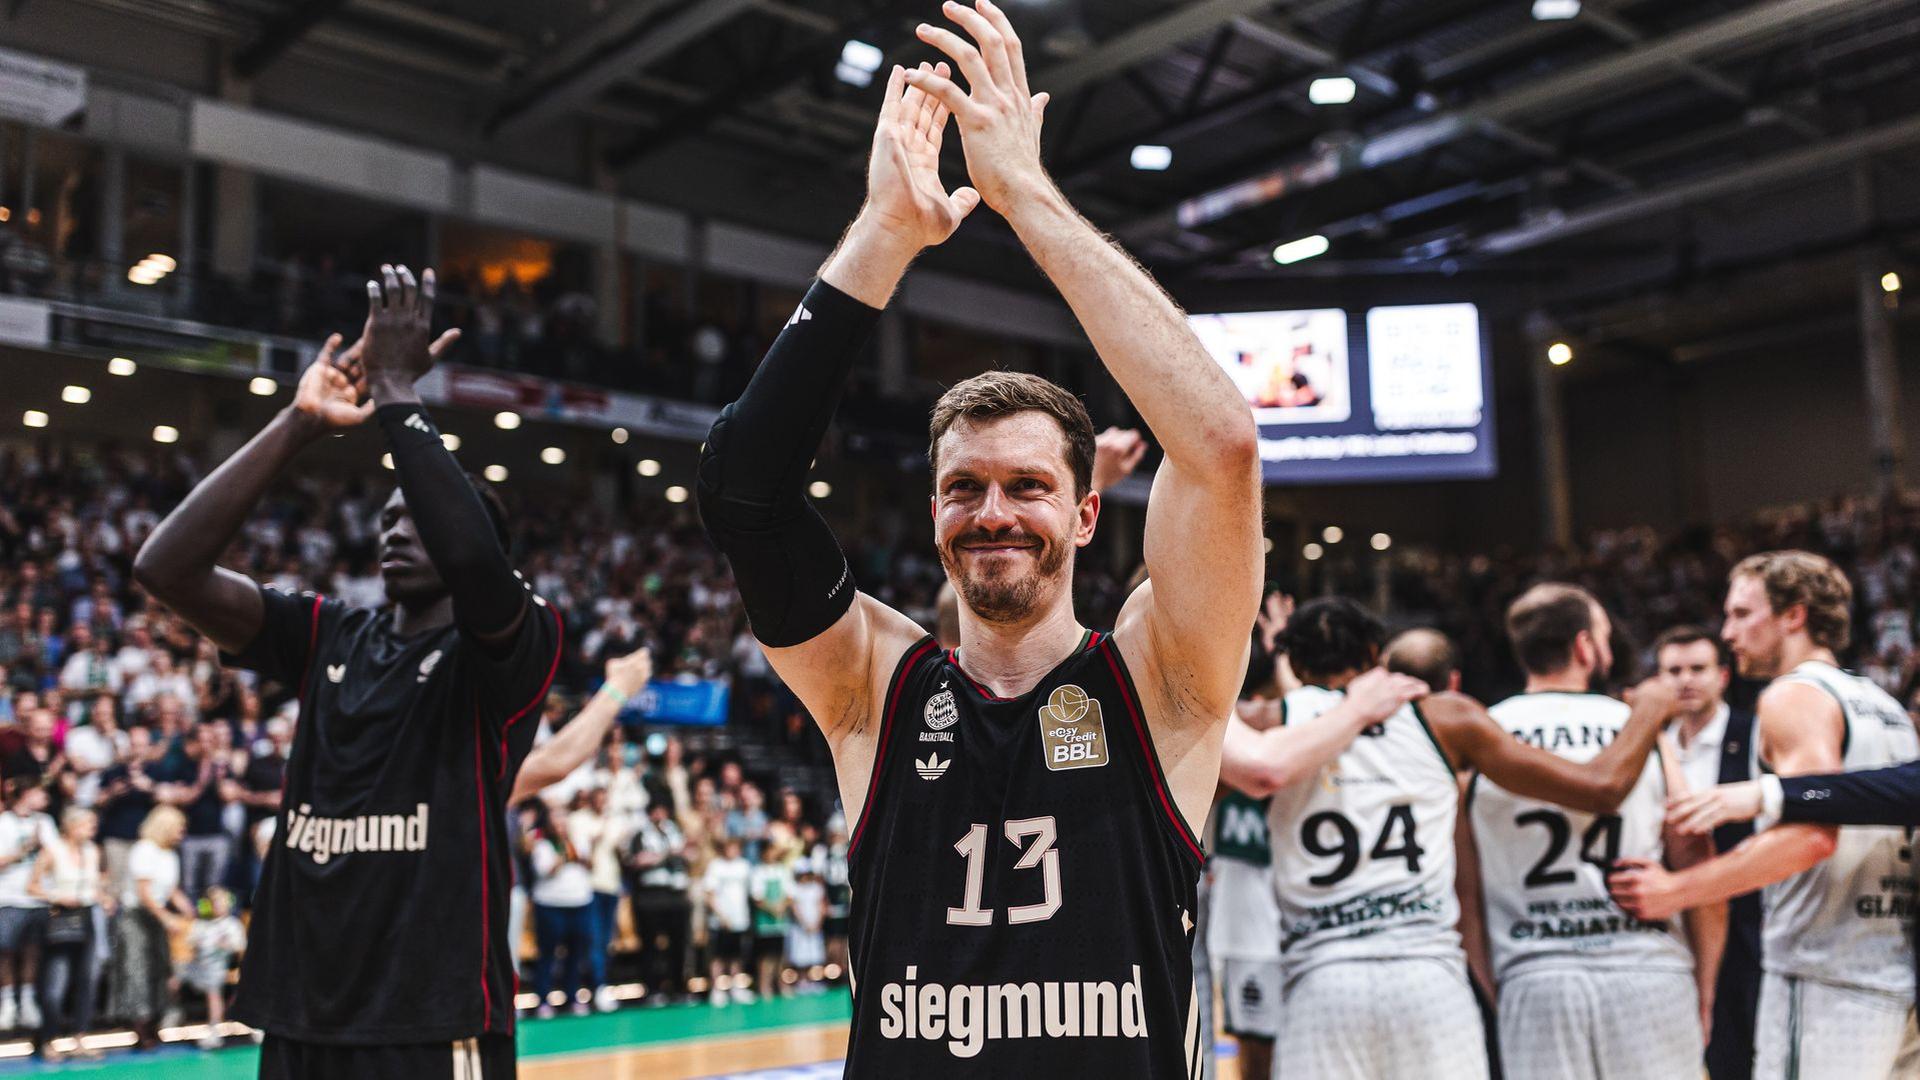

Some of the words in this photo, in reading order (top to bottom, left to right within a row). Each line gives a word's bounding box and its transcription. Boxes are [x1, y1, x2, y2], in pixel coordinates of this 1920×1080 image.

[919, 731, 954, 742] BASKETBALL
[1053, 741, 1099, 763] BBL
[946, 815, 1063, 926] 13
[1302, 804, 1425, 887] 94
[1515, 808, 1622, 889] 24
[880, 964, 1148, 1058] siegmund
